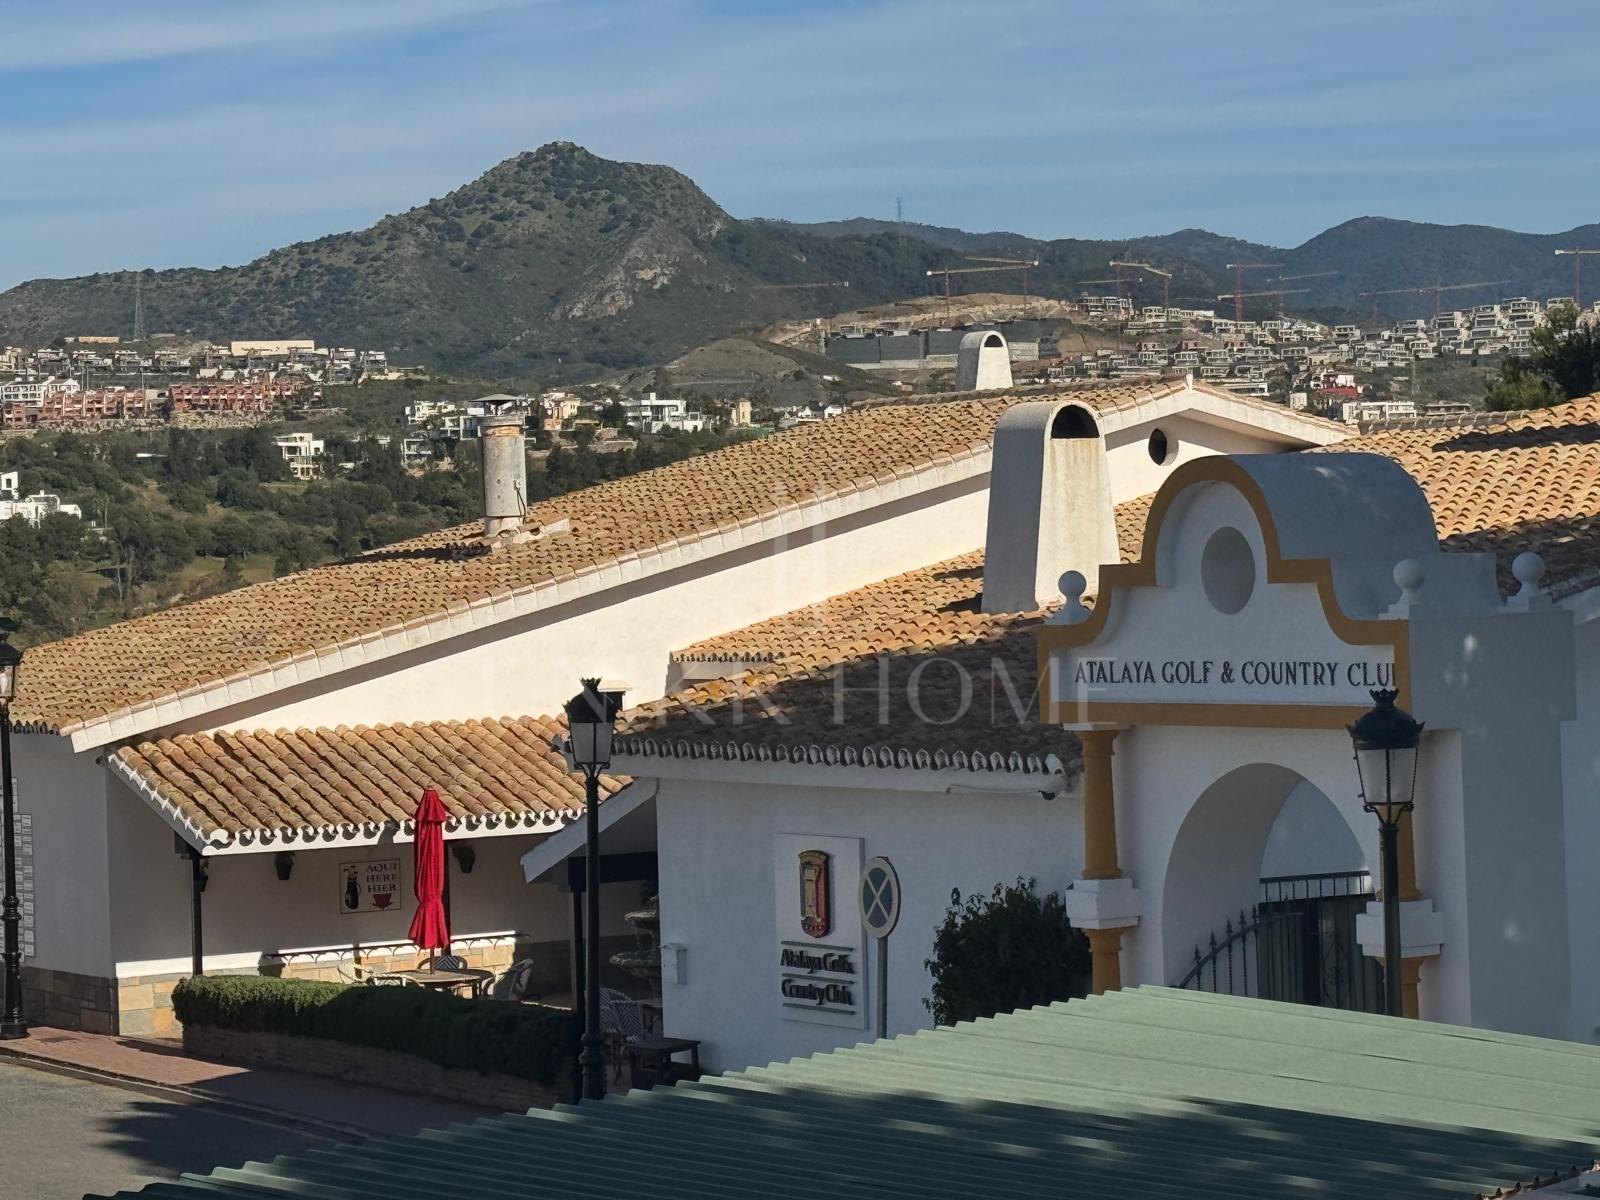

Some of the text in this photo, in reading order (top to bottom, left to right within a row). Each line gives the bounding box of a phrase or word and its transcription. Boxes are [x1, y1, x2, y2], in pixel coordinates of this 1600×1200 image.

[1075, 660, 1156, 684] ATALAYA
[1162, 660, 1214, 685] GOLF
[1220, 661, 1236, 685] &
[1241, 661, 1339, 686] COUNTRY
[781, 978, 854, 1006] Country Club
